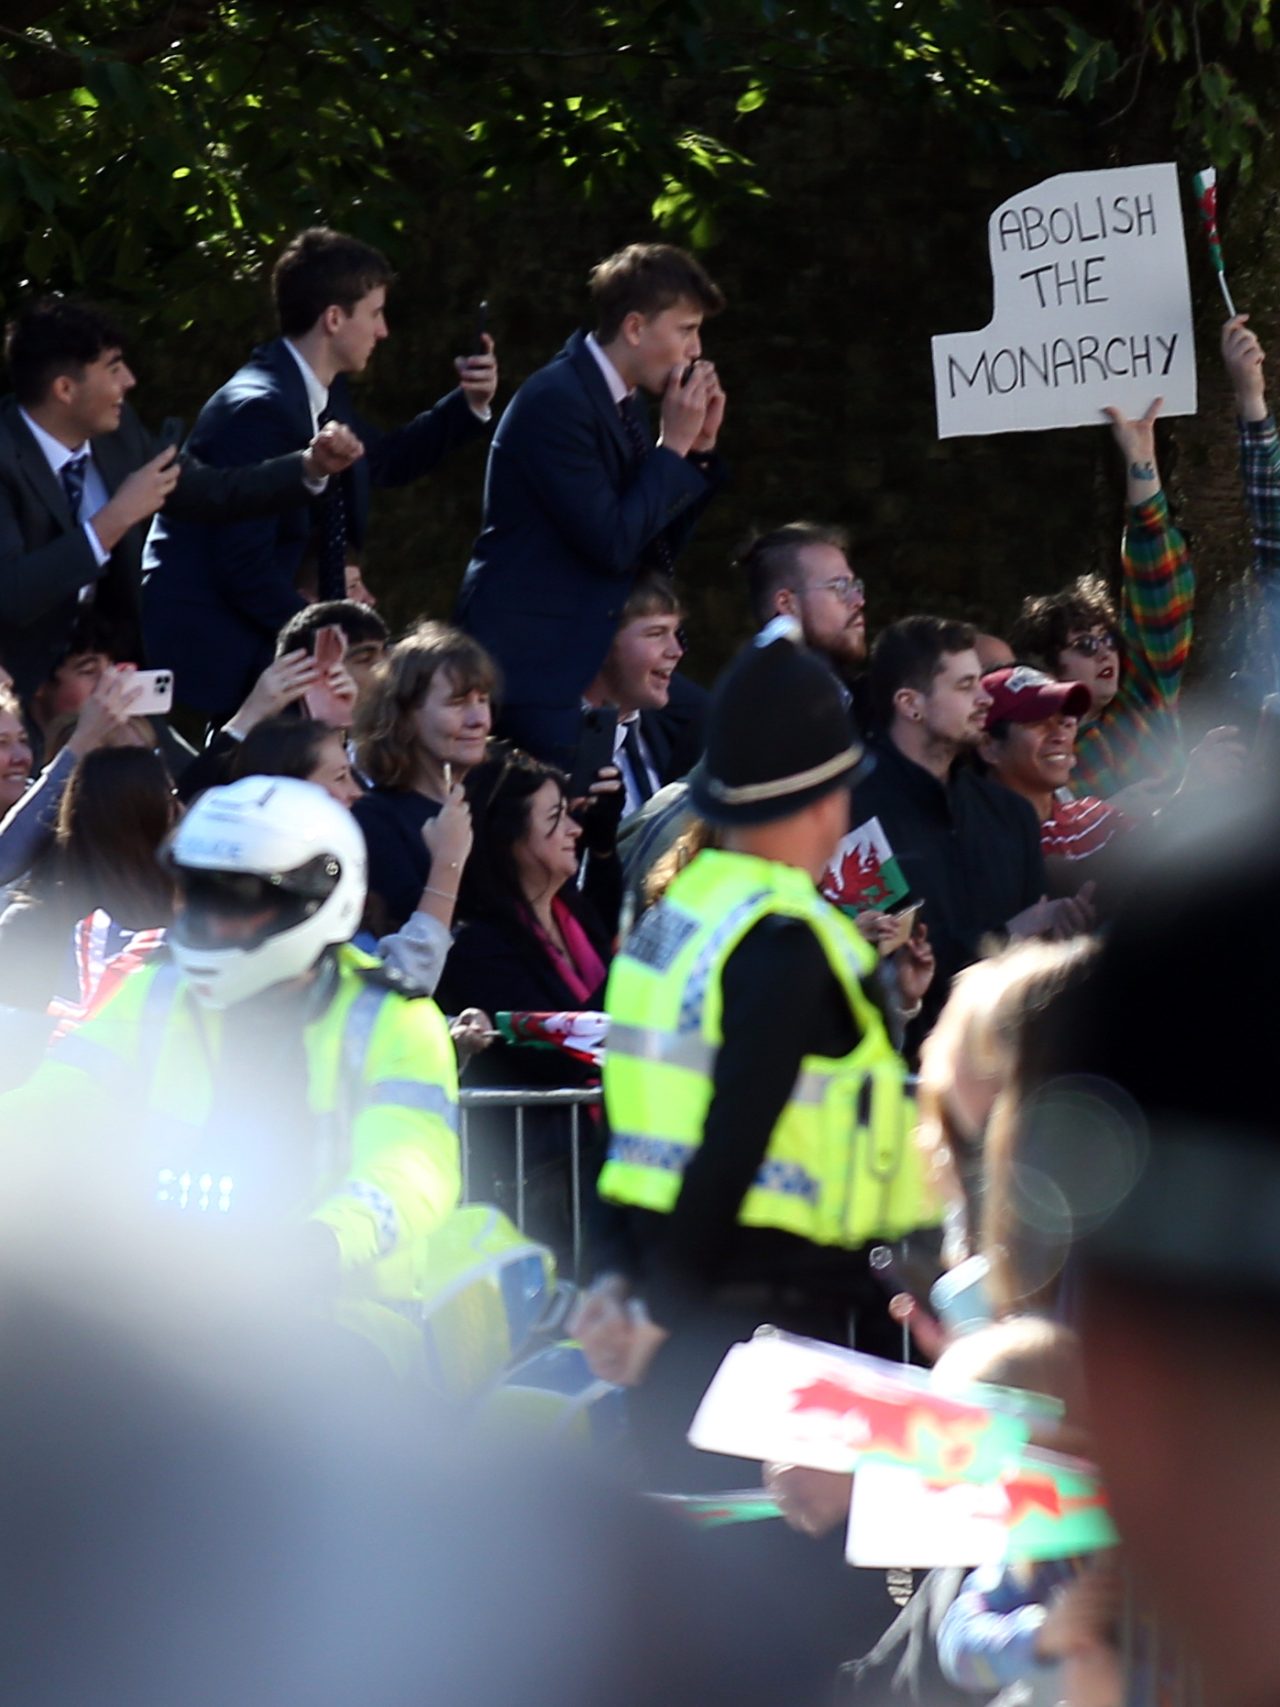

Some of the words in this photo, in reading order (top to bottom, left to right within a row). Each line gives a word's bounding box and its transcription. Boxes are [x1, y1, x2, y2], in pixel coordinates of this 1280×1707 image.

[999, 193, 1157, 251] ABOLISH
[1019, 256, 1109, 308] THE
[948, 333, 1179, 399] MONARCHY
